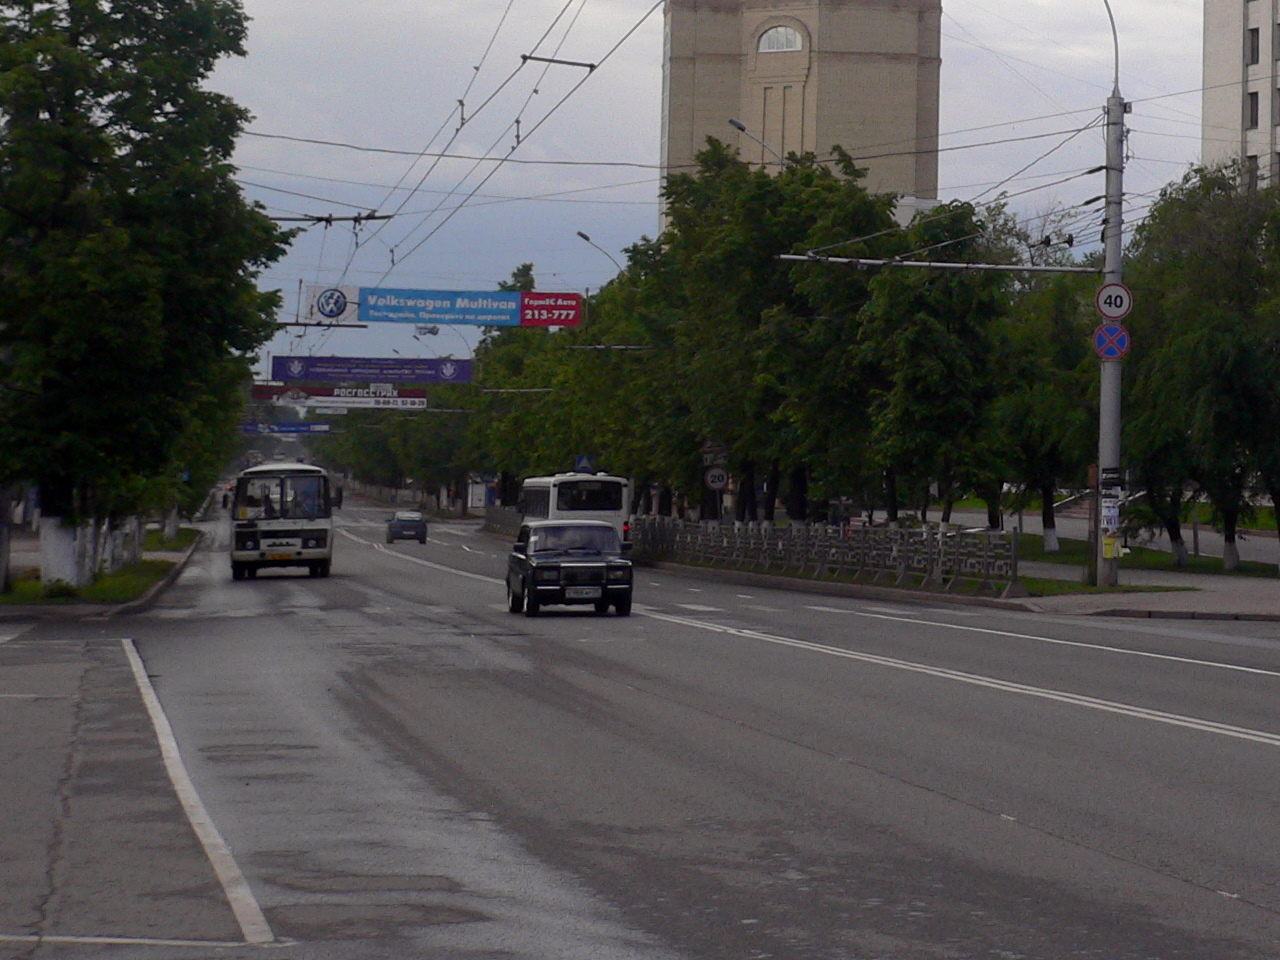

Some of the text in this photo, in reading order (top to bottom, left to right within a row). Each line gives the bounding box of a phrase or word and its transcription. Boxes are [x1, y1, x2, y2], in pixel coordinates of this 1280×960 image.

[367, 295, 516, 310] Volkswagen Multivan
[1104, 294, 1123, 308] 40
[524, 309, 576, 320] 213-777
